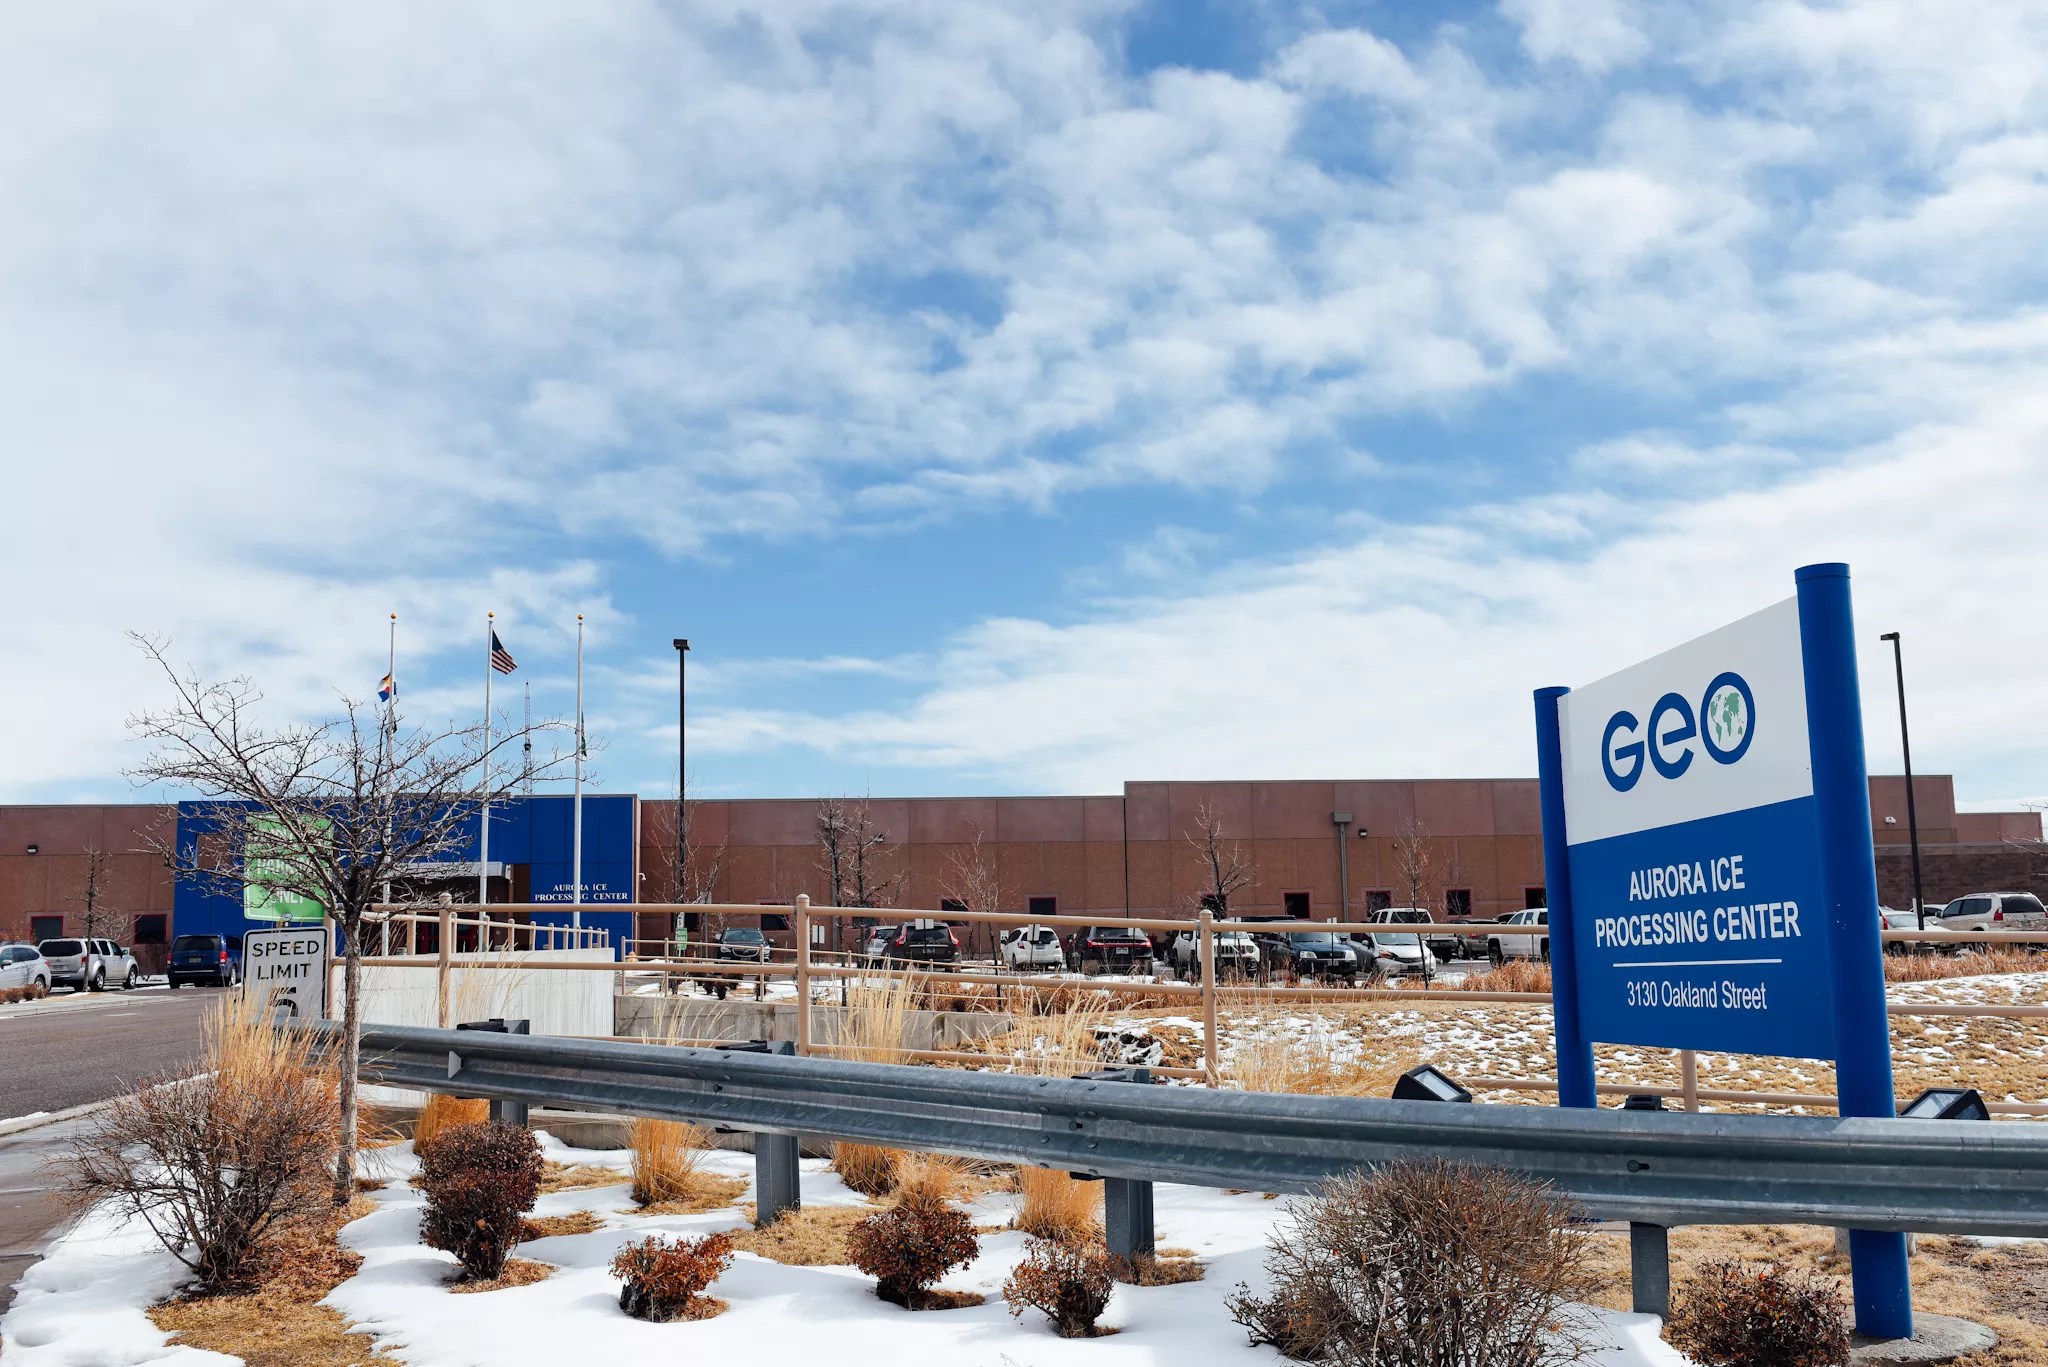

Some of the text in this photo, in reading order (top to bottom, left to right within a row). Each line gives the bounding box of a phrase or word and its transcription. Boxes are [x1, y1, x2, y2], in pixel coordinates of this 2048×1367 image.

[593, 883, 607, 891] ICE
[1629, 855, 1746, 902] AURORA ICE
[535, 892, 628, 902] PROCESSG CENTER
[1595, 900, 1802, 948] PROCESSING CENTER
[252, 940, 319, 957] SPEED
[257, 963, 311, 980] LIMIT
[1627, 980, 1768, 1010] 3130 Oakland Street
